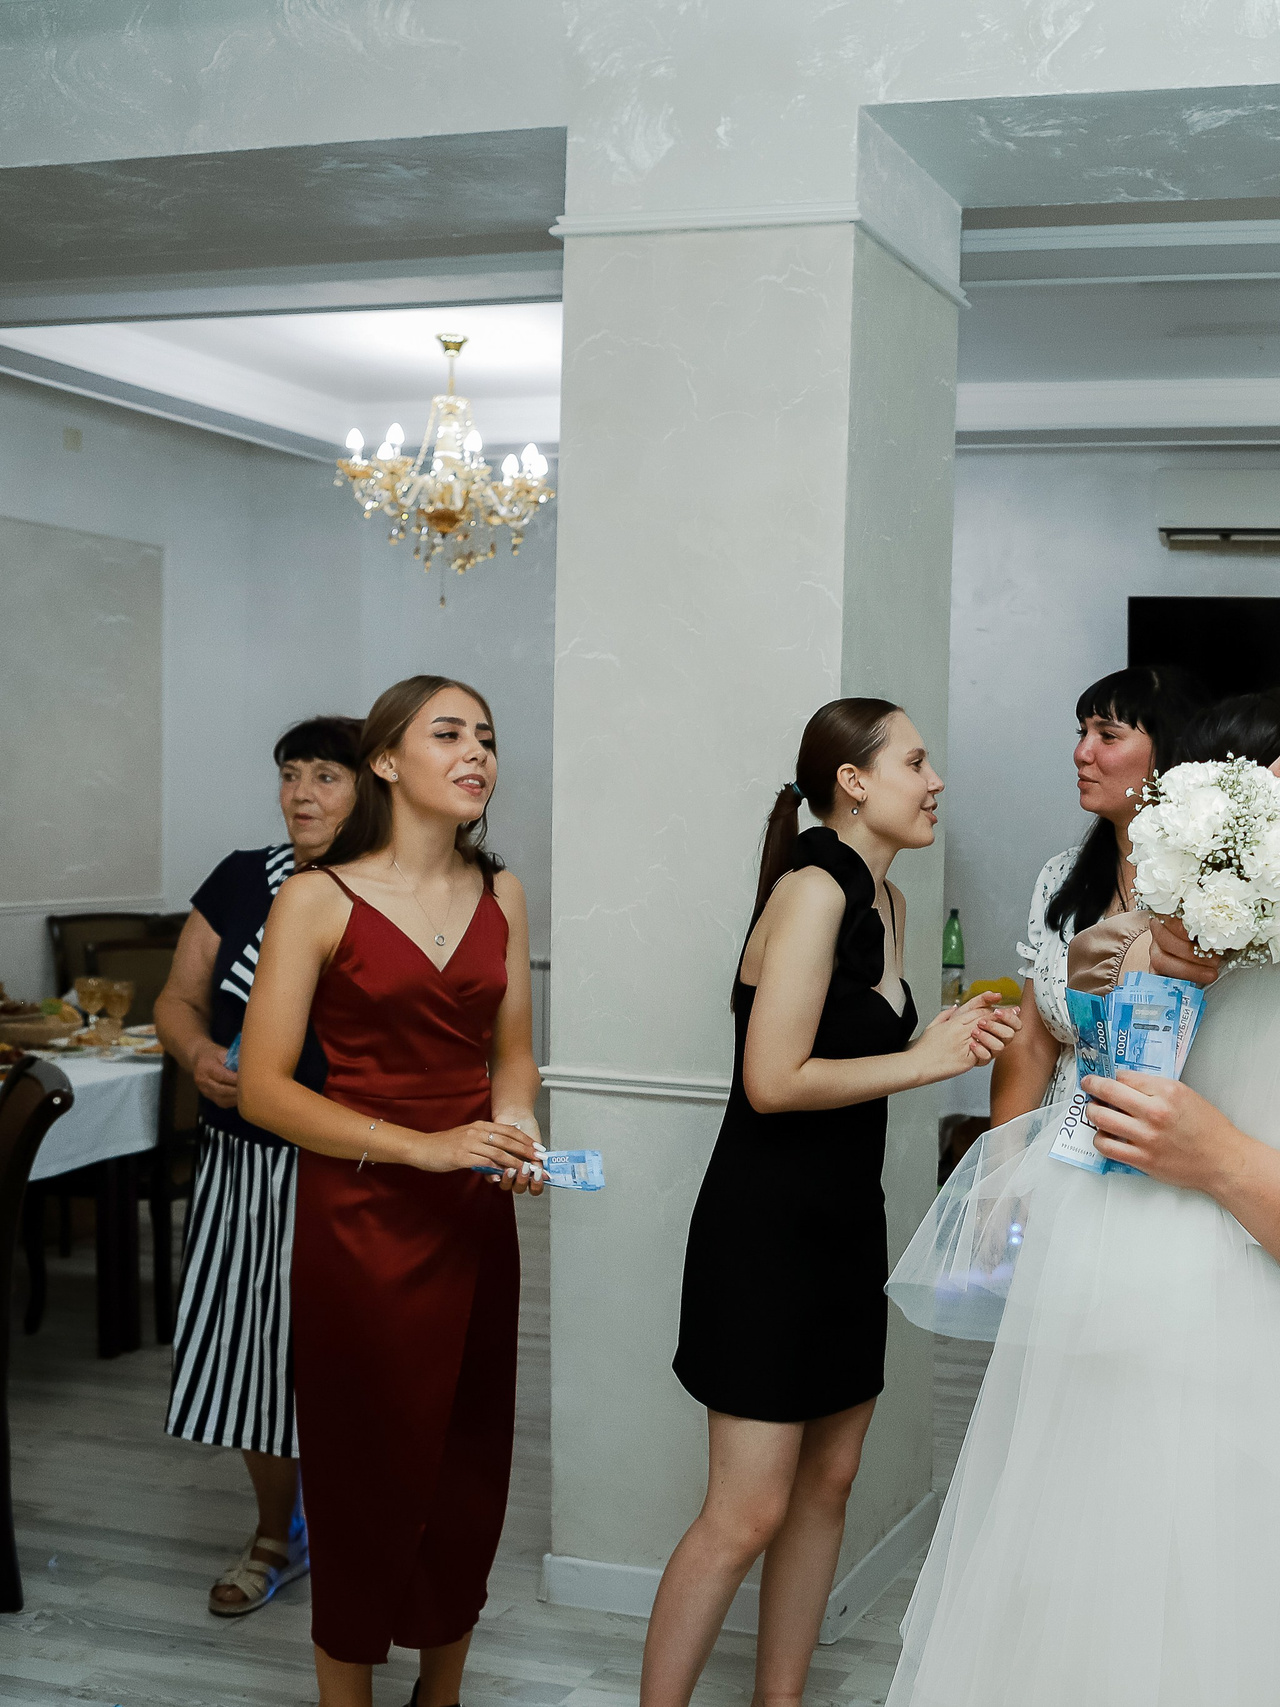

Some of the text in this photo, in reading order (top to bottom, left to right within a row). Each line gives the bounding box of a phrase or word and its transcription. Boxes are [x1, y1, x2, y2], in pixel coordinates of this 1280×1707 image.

[1096, 1021, 1108, 1051] 2000
[1116, 1028, 1127, 1056] 2000
[1059, 1093, 1085, 1140] 2000
